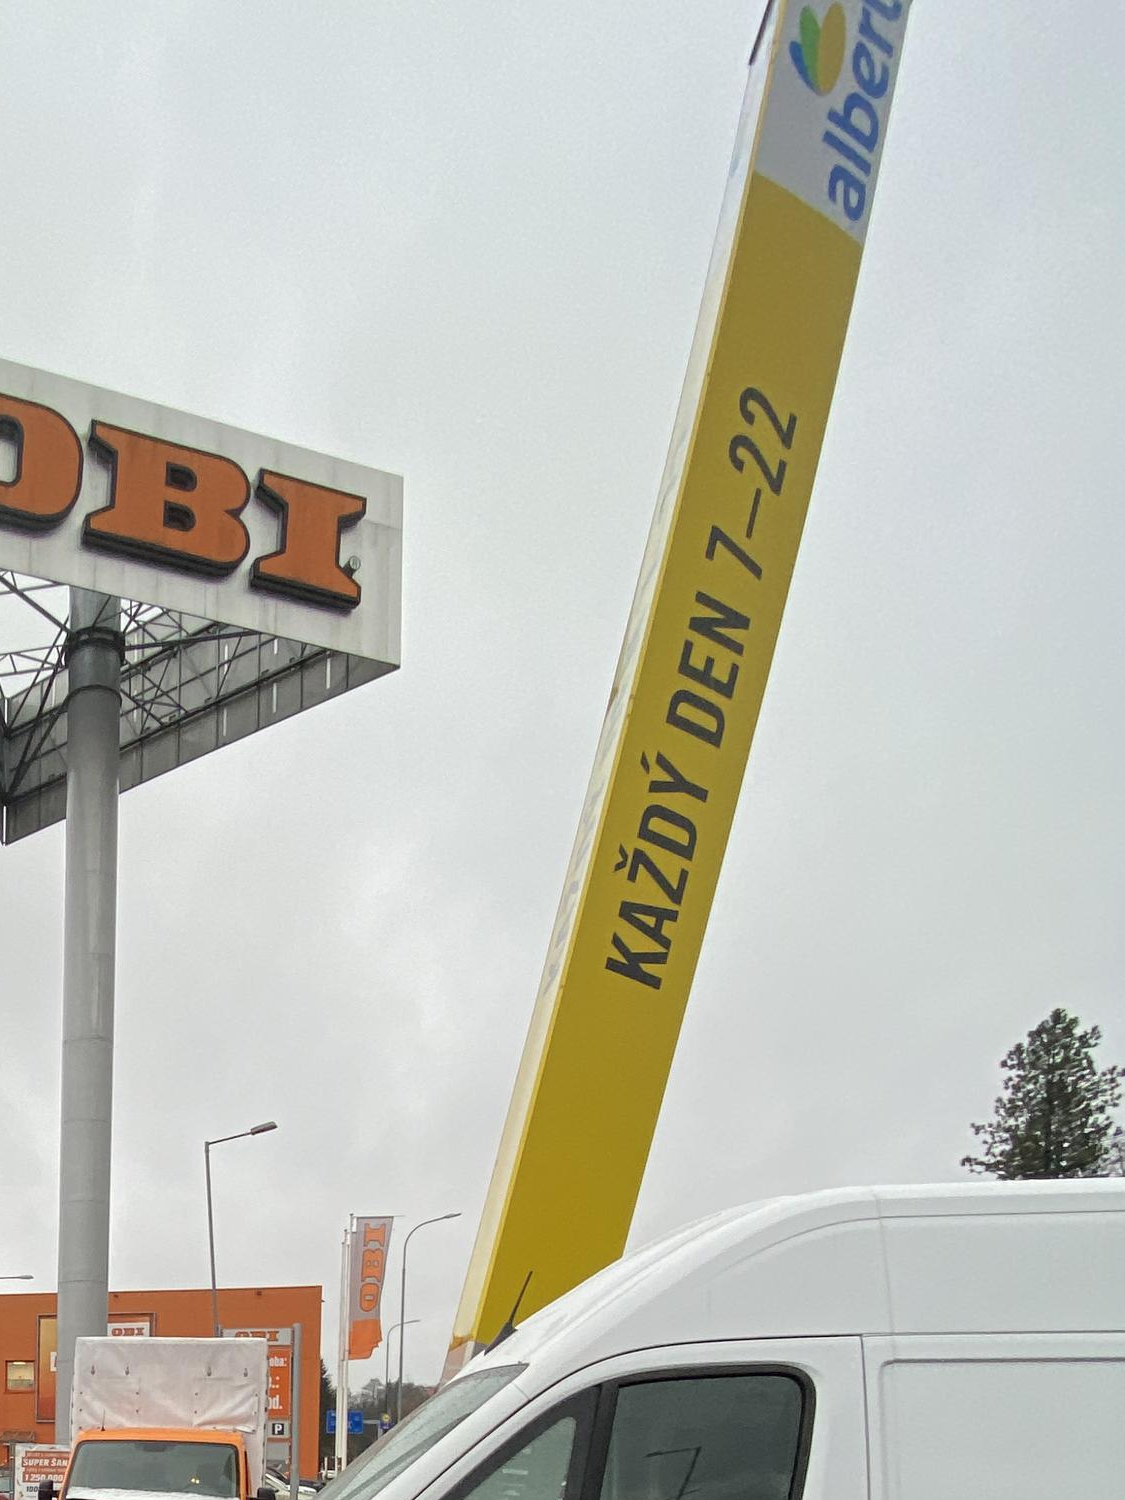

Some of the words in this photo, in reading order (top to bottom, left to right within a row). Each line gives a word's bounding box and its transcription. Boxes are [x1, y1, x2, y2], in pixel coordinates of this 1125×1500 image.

[605, 751, 709, 990] KAŽDÝ
[665, 590, 751, 749] DEN
[359, 1222, 387, 1313] OBI
[111, 1327, 145, 1337] OBI
[274, 1424, 283, 1434] P
[22, 1458, 50, 1467] SUPER
[50, 1457, 68, 1467] ŠAN
